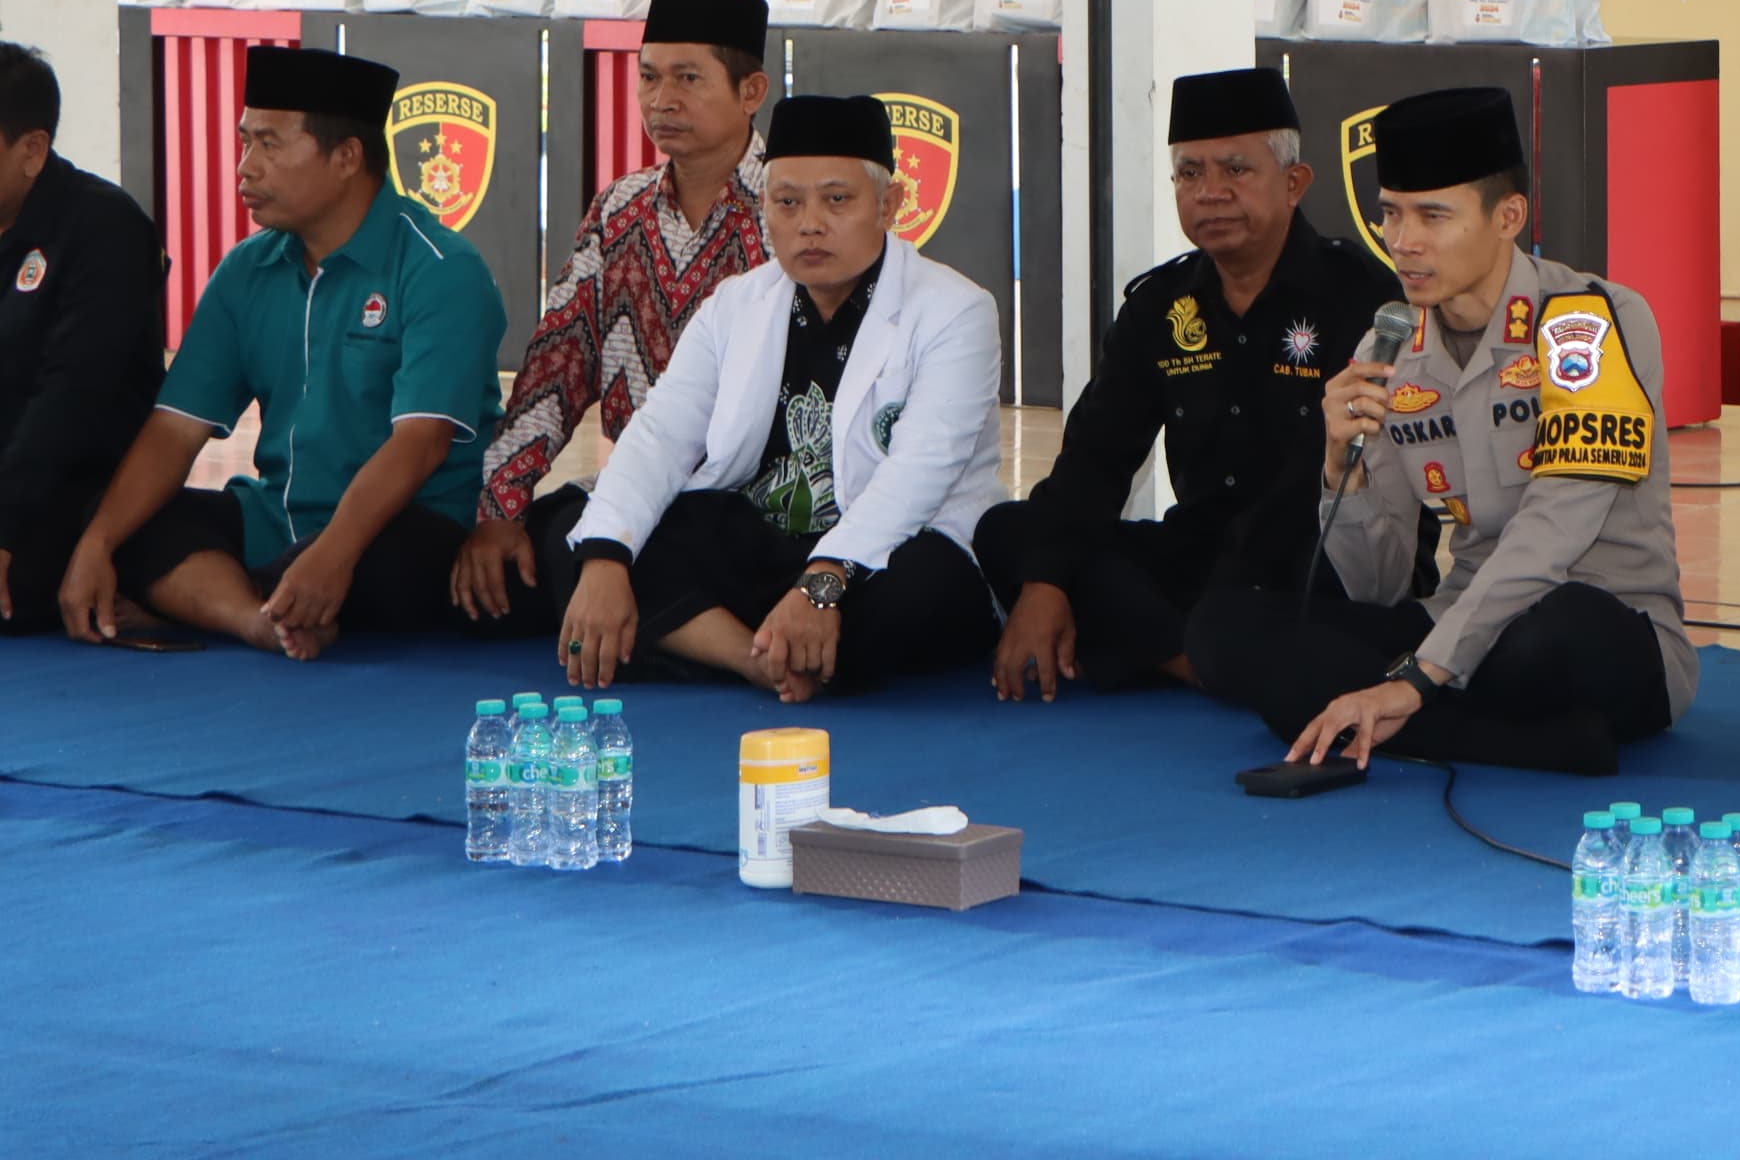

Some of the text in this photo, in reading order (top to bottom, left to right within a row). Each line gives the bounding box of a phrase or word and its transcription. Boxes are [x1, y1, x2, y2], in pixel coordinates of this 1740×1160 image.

[399, 92, 483, 122] RESERSE
[885, 104, 945, 137] ERSE
[1274, 363, 1321, 379] CAB. TUBAN
[1493, 397, 1541, 428] POL
[1390, 415, 1456, 446] OSKAR
[1535, 412, 1646, 449] AOPSRES
[1559, 447, 1590, 465] PRAJA
[1591, 449, 1627, 467] SEMERU
